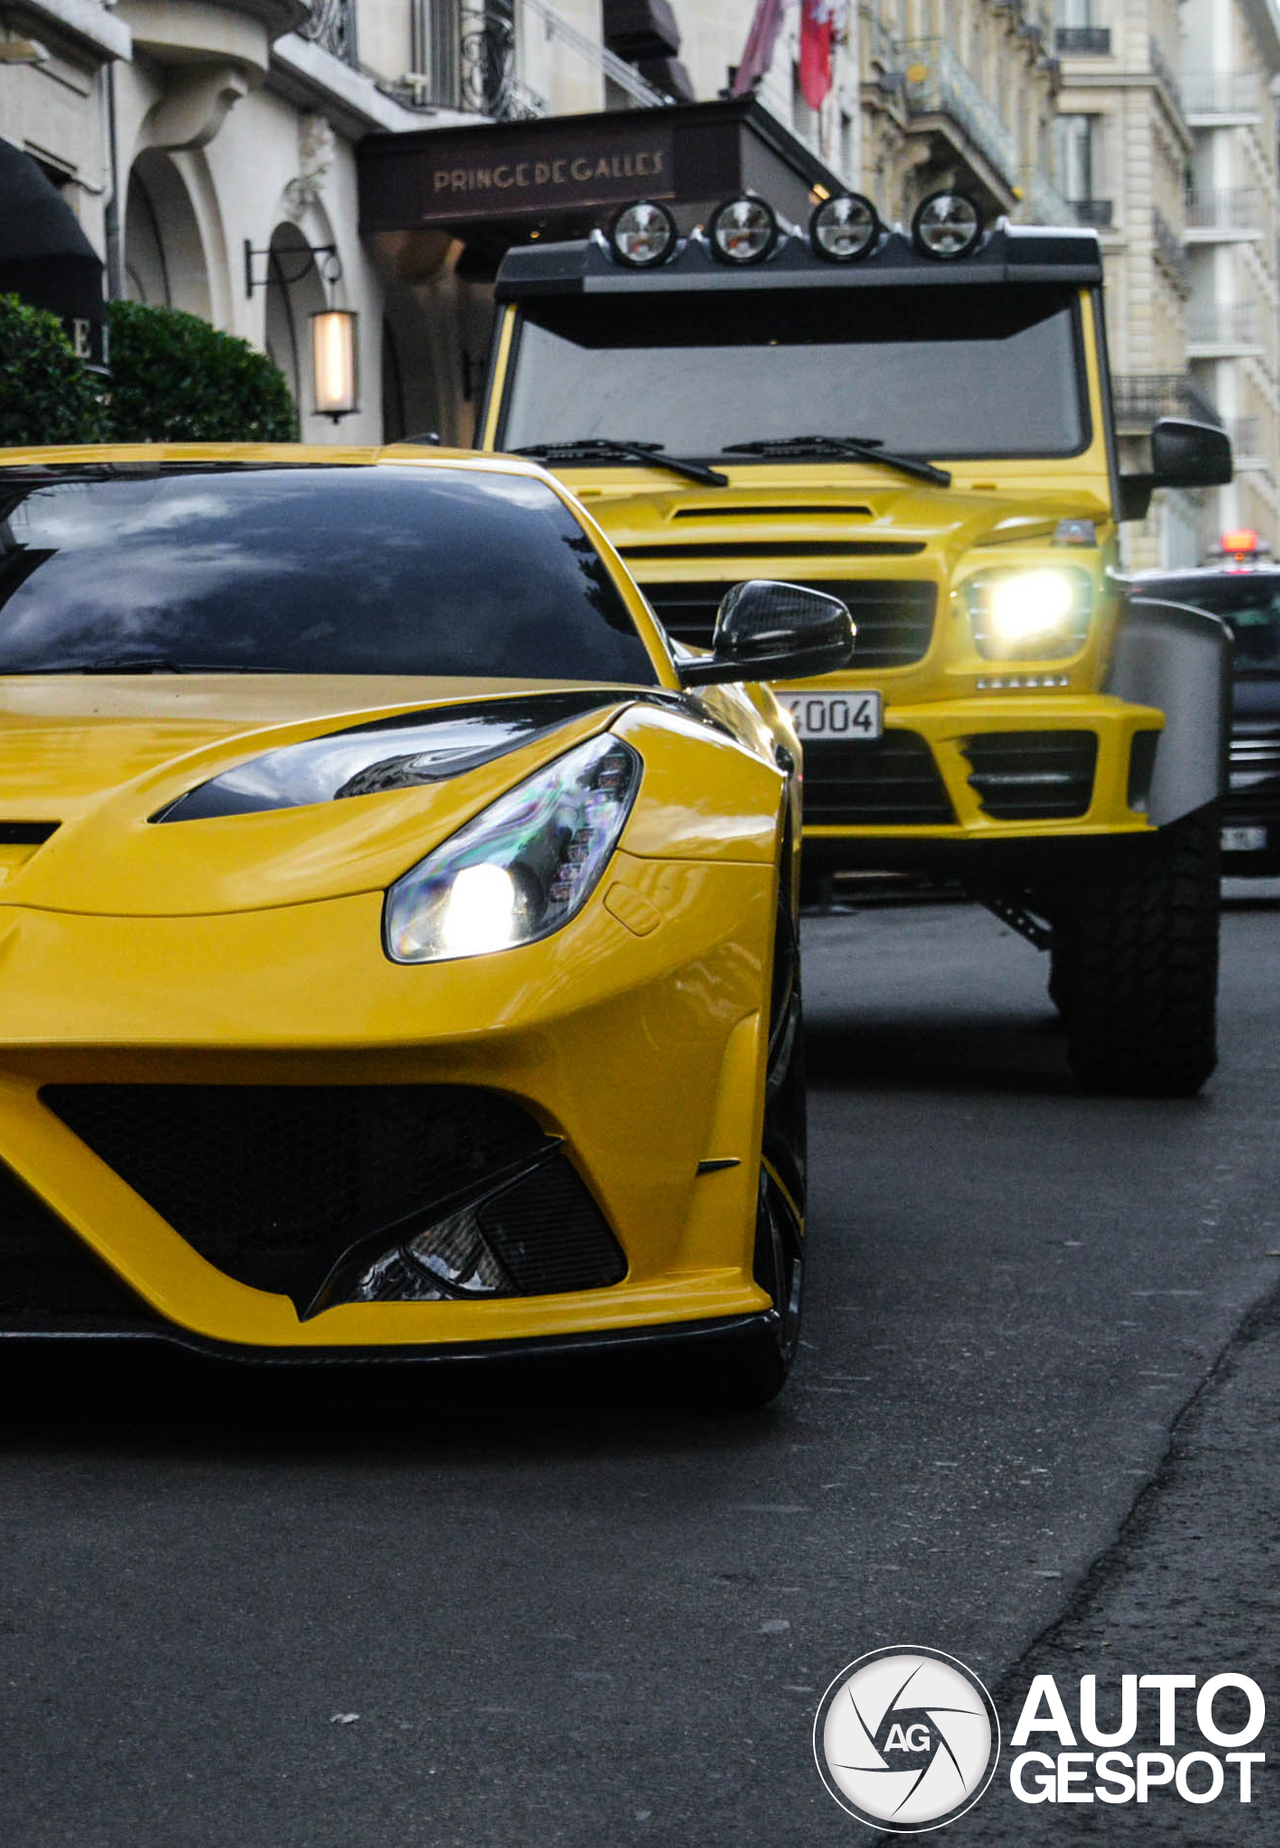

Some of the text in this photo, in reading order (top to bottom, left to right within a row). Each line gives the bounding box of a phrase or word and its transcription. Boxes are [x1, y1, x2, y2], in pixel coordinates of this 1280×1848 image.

[433, 151, 664, 193] PRINCE DE GALLES
